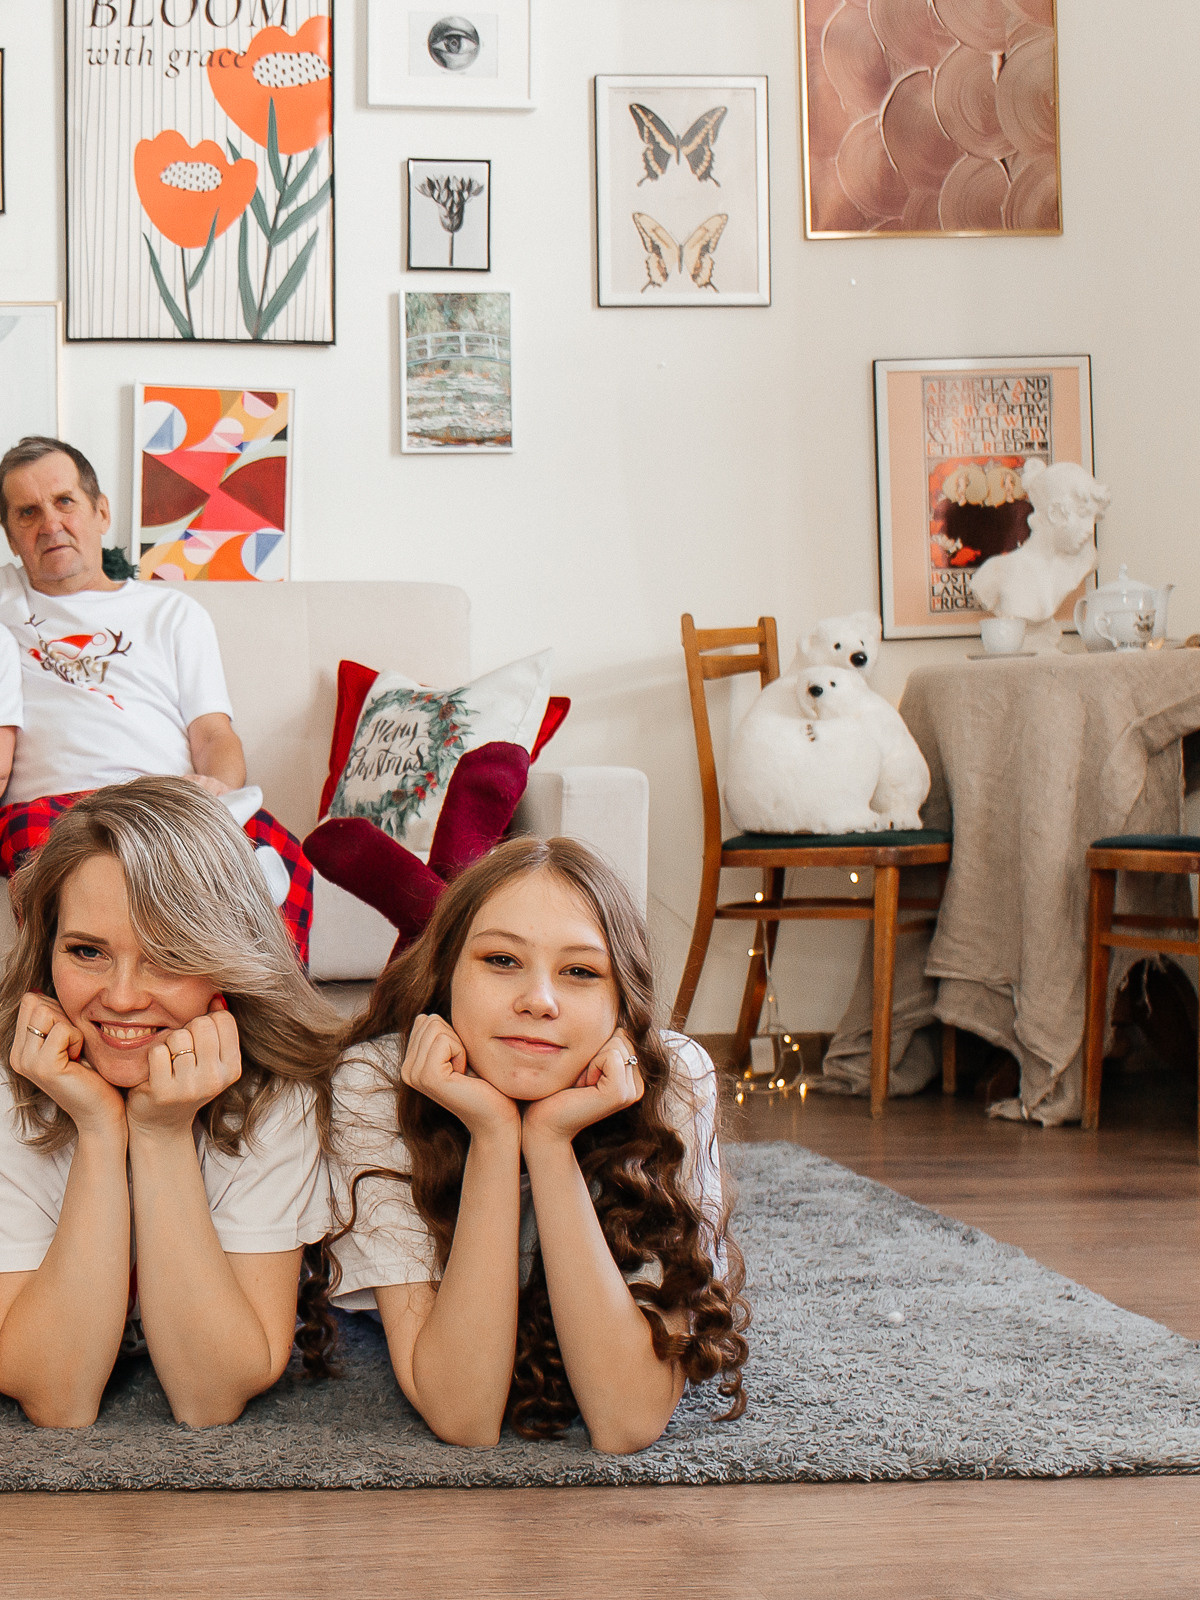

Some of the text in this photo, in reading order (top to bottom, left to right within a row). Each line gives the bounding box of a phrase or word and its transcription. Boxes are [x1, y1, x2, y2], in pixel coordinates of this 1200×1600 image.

[88, 0, 288, 28] BLOOM
[87, 35, 247, 78] with grace
[1012, 377, 1047, 392] AND
[1003, 415, 1048, 428] WITH
[932, 597, 975, 610] PRICE
[345, 743, 429, 781] Christmas
